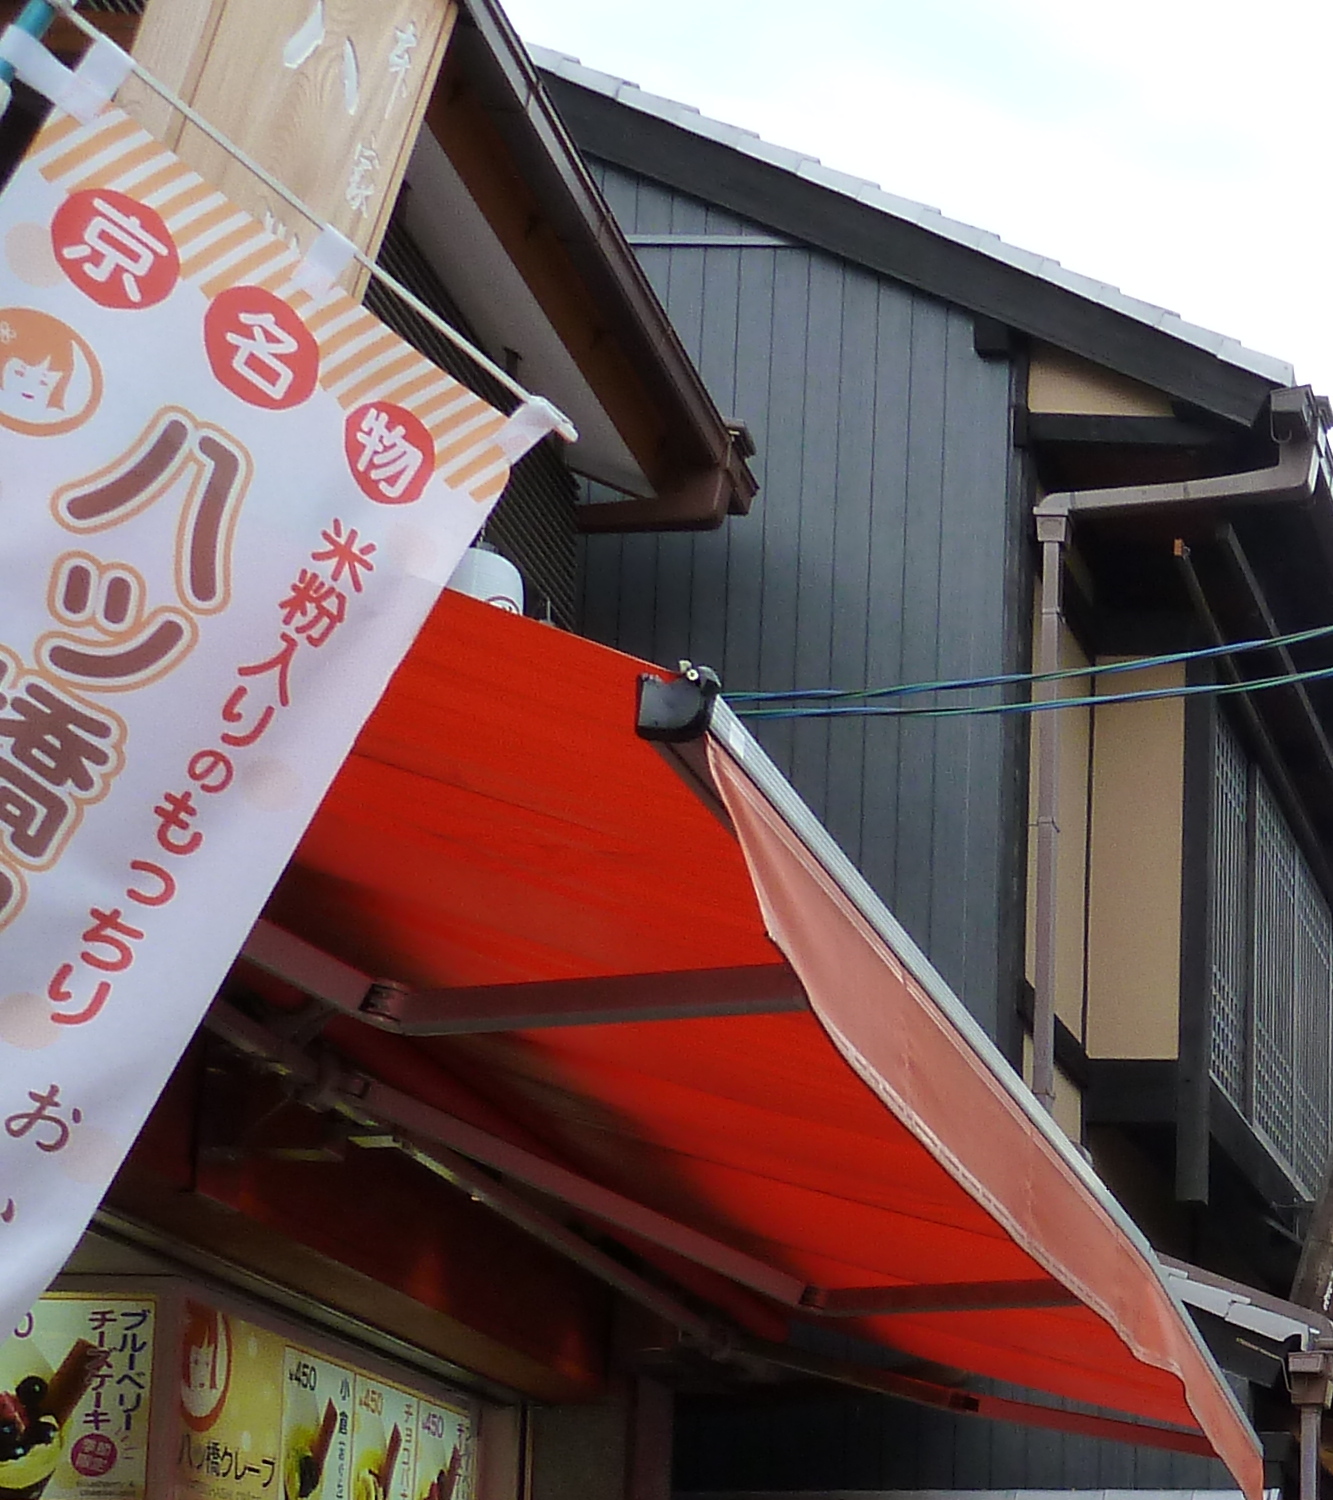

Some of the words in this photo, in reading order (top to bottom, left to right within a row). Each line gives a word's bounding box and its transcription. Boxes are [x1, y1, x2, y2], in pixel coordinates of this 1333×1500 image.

[62, 195, 428, 497] 京名物
[82, 1309, 118, 1431] チーズケーキ
[115, 1308, 152, 1431] ブルーベリー
